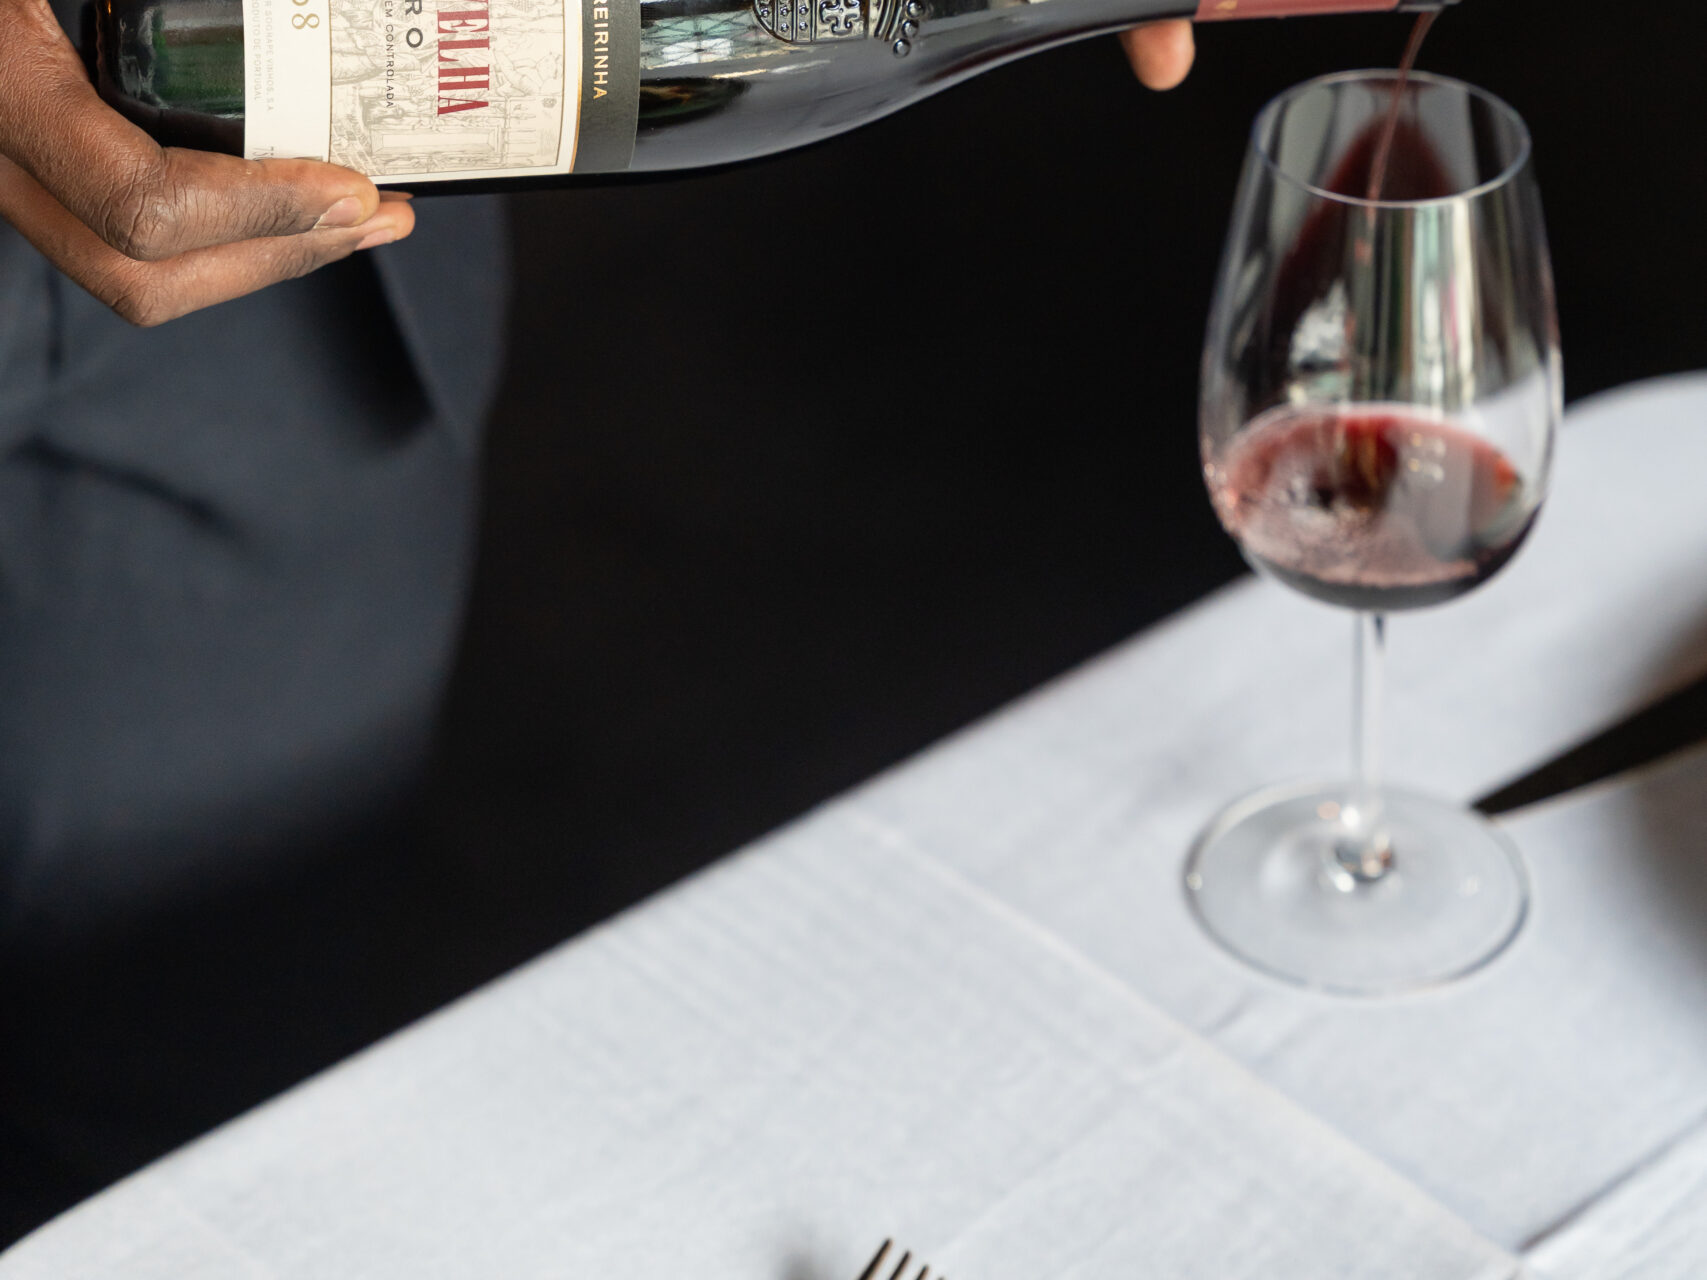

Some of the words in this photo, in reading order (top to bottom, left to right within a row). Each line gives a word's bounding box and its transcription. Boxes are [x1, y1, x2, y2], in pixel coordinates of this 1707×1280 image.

[253, 38, 262, 50] DE
[385, 24, 396, 109] CONTROLADA
[253, 53, 263, 101] PORTUGAL
